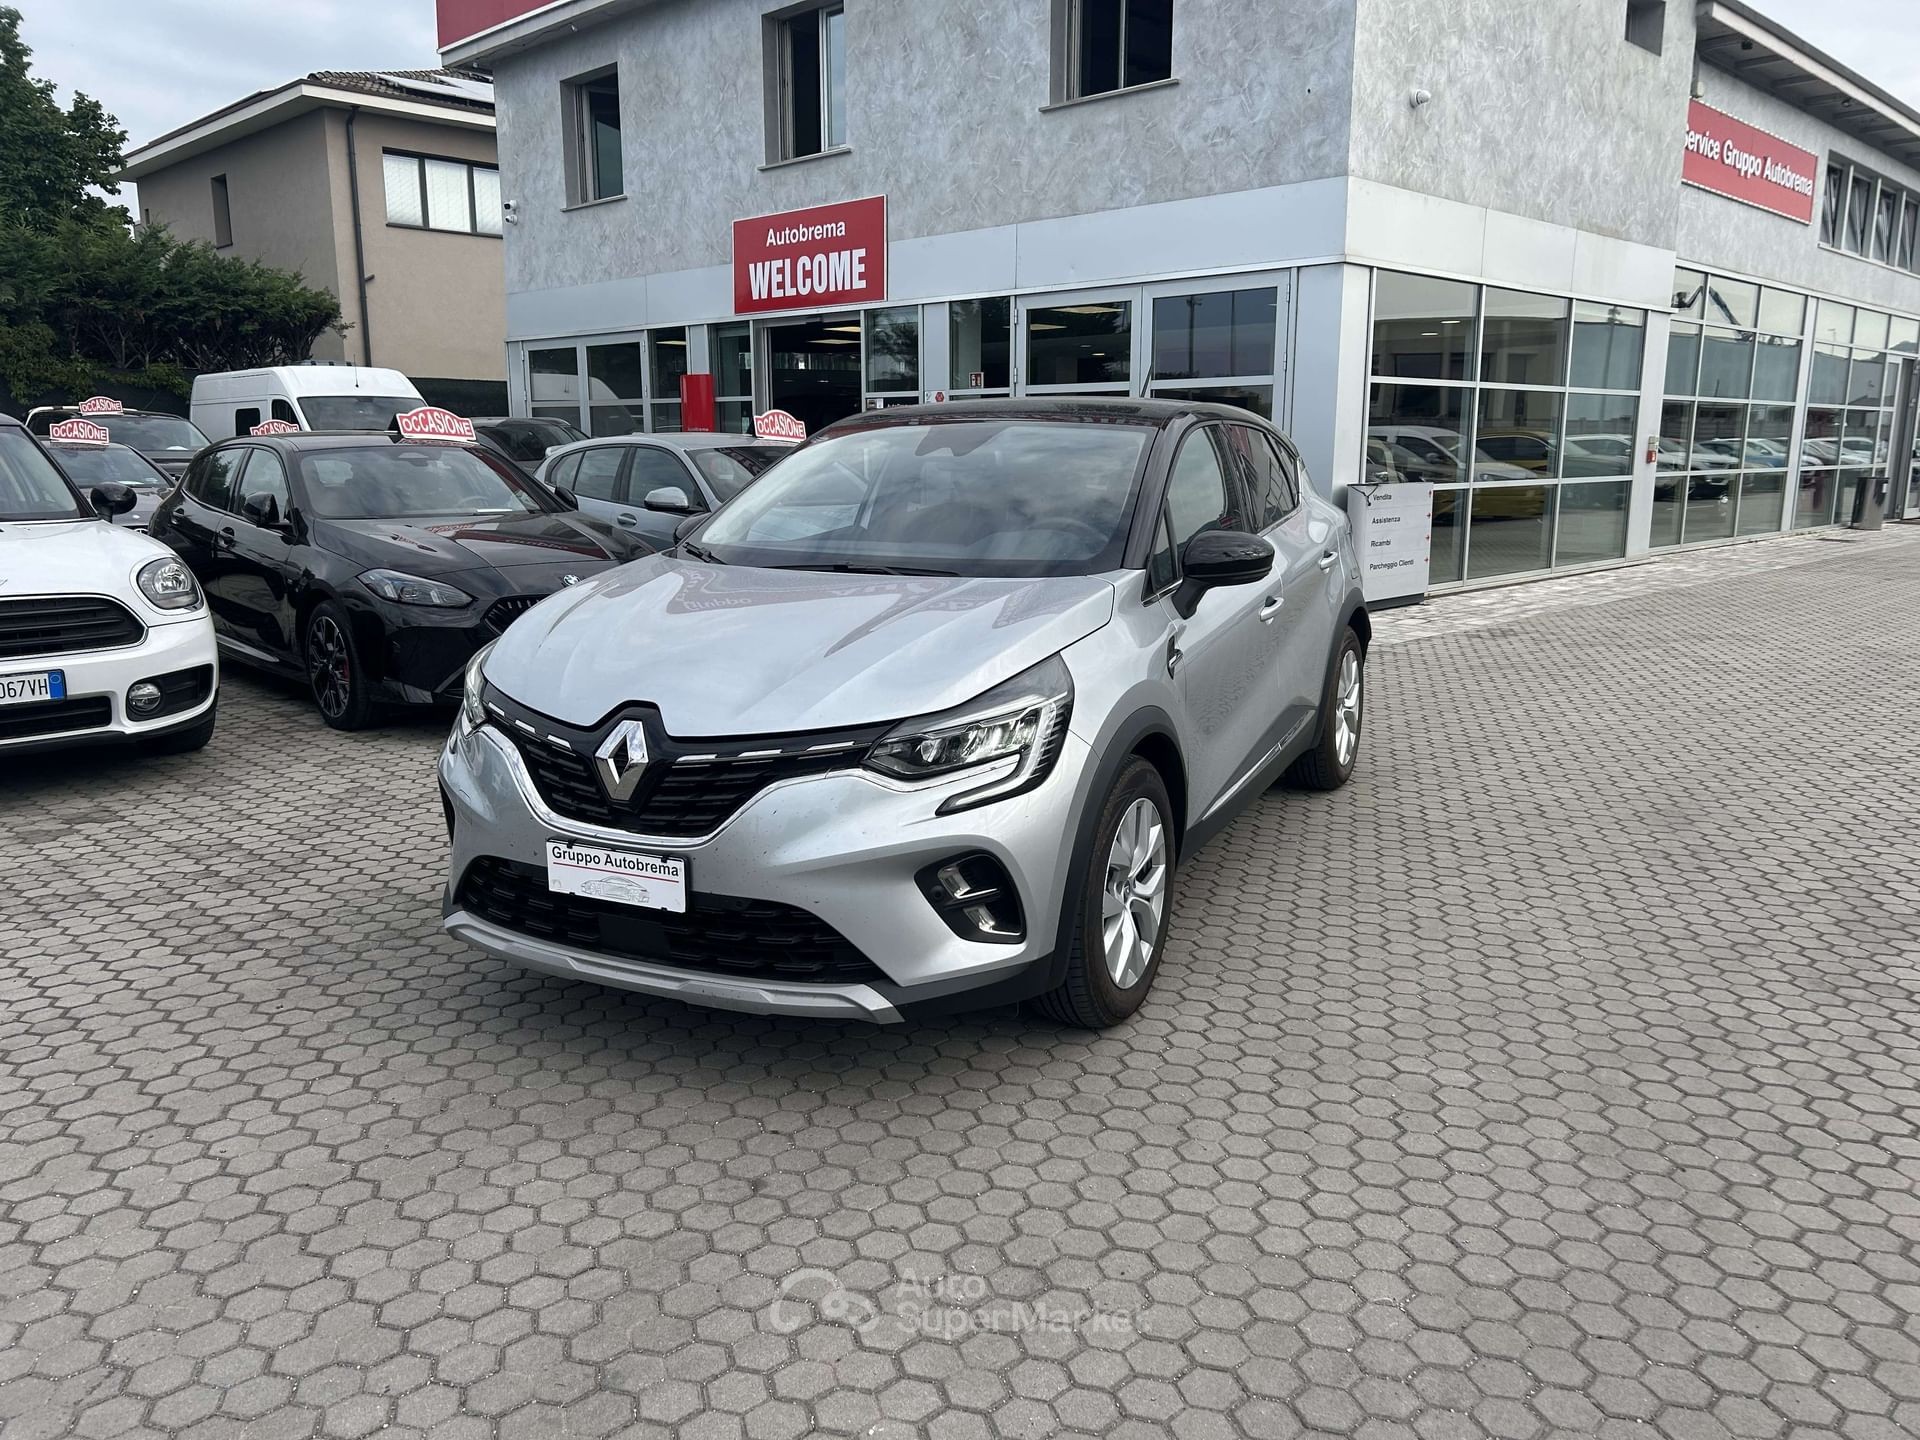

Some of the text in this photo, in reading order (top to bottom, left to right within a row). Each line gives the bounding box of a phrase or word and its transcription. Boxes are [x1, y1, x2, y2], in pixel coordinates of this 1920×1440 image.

[1723, 139, 1761, 178] Gruppo
[1763, 157, 1813, 196] Autobrema
[766, 221, 846, 247] Autobrema
[749, 248, 867, 300] WELCOME
[82, 399, 121, 411] OCCASIONE
[53, 422, 106, 440] OCCASIONE
[403, 411, 471, 436] OCCASIONE
[757, 414, 805, 437] OCCASIONE
[1372, 516, 1401, 524] Assistenza
[1370, 539, 1391, 548] Ricambi
[1369, 559, 1415, 571] Parcheggio Clienti
[551, 846, 679, 877] Gruppo Autobrema
